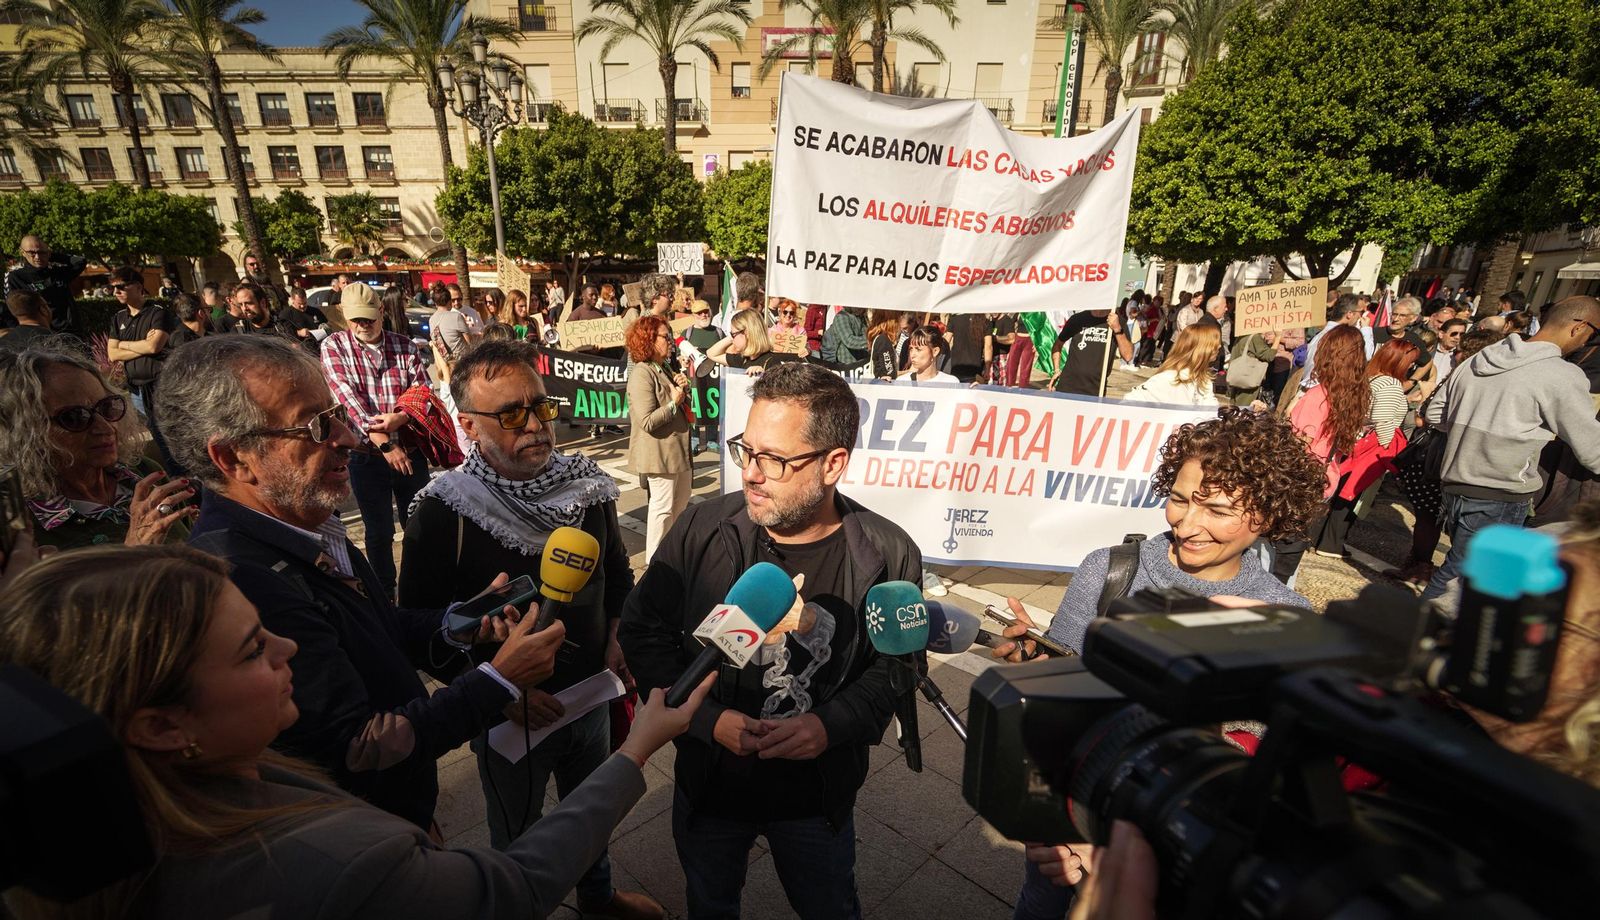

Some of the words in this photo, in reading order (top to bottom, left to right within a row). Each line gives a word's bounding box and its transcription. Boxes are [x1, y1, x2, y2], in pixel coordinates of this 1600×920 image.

[1062, 64, 1076, 138] GENOCIDI
[794, 125, 821, 150] SE
[825, 131, 944, 165] ACABARON
[947, 146, 989, 171] LAS
[994, 152, 1055, 184] CASAS
[818, 193, 860, 217] LOS
[776, 245, 797, 268] LA
[804, 250, 842, 273] PAZ
[845, 254, 897, 278] PARA
[902, 260, 940, 283] LOS
[944, 263, 1110, 287] ESPECULADORES
[1238, 291, 1260, 303] AMA
[1264, 288, 1277, 300] TU
[1284, 300, 1302, 310] AL
[564, 319, 623, 336] DESAHUCIA
[566, 338, 575, 348] A
[946, 402, 1054, 463] PARA
[1071, 415, 1178, 474] VIVI
[864, 457, 981, 492] DERECHO
[983, 465, 999, 494] A
[1004, 467, 1036, 497] LA
[1044, 470, 1167, 509] VIVIEND
[944, 508, 989, 523] JEREZ
[954, 527, 994, 537] VIVIENDA
[550, 547, 595, 573] SER
[900, 618, 927, 630] Noticias
[717, 635, 746, 662] ATLAS
